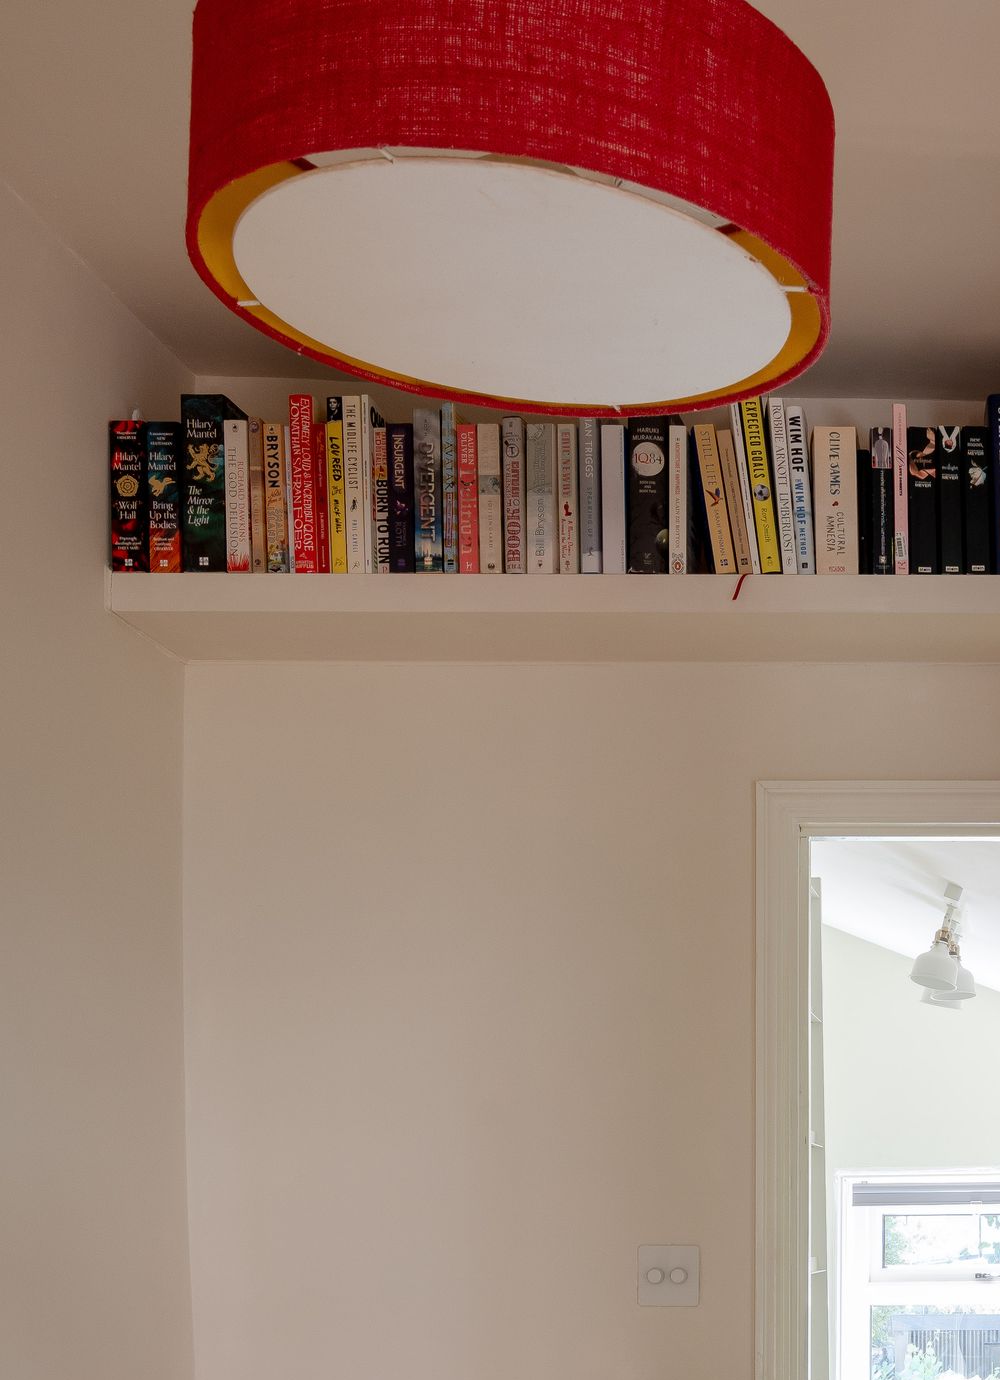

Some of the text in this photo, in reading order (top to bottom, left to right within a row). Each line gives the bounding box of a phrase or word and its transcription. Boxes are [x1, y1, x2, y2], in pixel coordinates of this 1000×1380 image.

[186, 419, 213, 430] Hilary
[186, 428, 216, 438] Mantel
[300, 398, 310, 445] EXTREMELY
[745, 401, 761, 446] EXPECTED
[789, 416, 802, 443] WIM
[115, 451, 138, 463] Hilary
[149, 452, 173, 463] Hilary
[302, 448, 312, 471] LOUD
[329, 437, 342, 481] LOU REED
[346, 404, 358, 490] THE MIDLIFE CYCLIST
[584, 419, 593, 478] IAN TRIGGS
[635, 452, 662, 464] 1Q84
[700, 431, 717, 486] STILL LIFE
[791, 448, 804, 472] HOF
[113, 462, 141, 470] Mantel
[148, 462, 176, 470] Mantel
[267, 435, 280, 488] BRYSON
[290, 400, 303, 550] JONATHAN SAFRAN FOER
[393, 434, 405, 489] INSURGENT
[444, 442, 453, 493] AVATAR
[751, 450, 765, 479] GOALS
[829, 432, 841, 496] CLIVE JAMES
[187, 486, 202, 495] The
[418, 443, 436, 541] DIVERGENT
[772, 405, 793, 553] ROBBIE ARNOTT LIMBERLOST
[795, 483, 805, 503] WIM
[118, 501, 137, 510] Wolf
[153, 501, 173, 511] Bring
[187, 496, 214, 505] Mirror
[187, 506, 210, 515] & the
[228, 448, 239, 557] THE GOD DELUSION
[303, 480, 313, 524] INCREDIBLY
[120, 511, 136, 519] Hall
[149, 511, 177, 521] Up the
[150, 520, 177, 529] Bodies
[188, 515, 210, 525] Light
[376, 480, 389, 564] BORN TO RUN
[535, 498, 545, 536] Bryson
[797, 506, 806, 524] HOF
[304, 523, 313, 551] CLOSE
[507, 508, 520, 562] BOOK
[716, 529, 725, 557] WINMAN
[763, 523, 772, 543] Smith
[799, 527, 807, 555] METHOD
[826, 515, 836, 552] AMNESIA
[836, 512, 845, 556] CULTURAL
